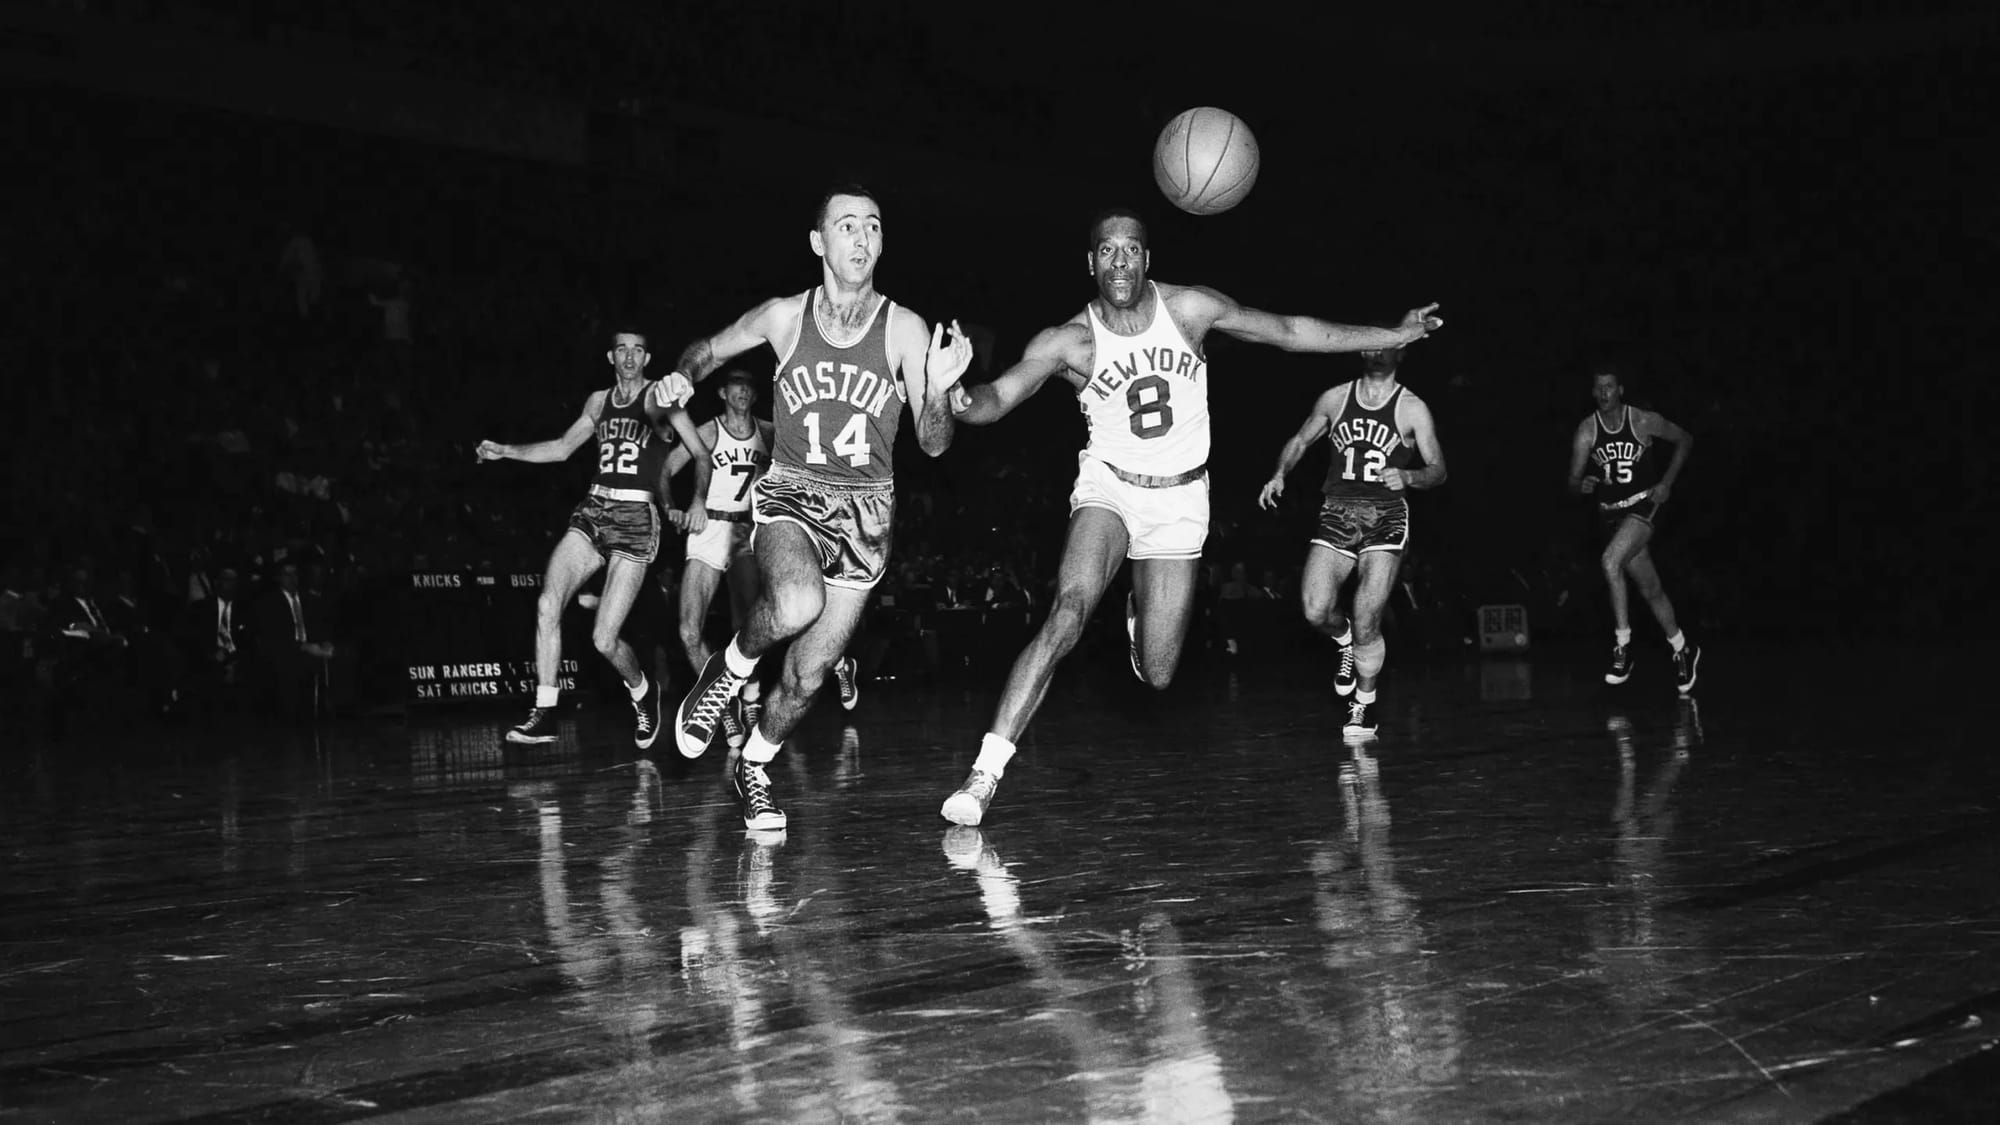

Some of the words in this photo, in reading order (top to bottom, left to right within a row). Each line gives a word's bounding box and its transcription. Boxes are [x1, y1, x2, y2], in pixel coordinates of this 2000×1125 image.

[779, 361, 894, 418] BOSTON
[1088, 352, 1138, 401] NEW
[1143, 346, 1202, 383] YORK
[1126, 374, 1174, 440] 8
[598, 417, 653, 449] OSTON
[803, 412, 871, 467] 14
[1331, 418, 1401, 457] BOSTON
[599, 441, 640, 475] 22
[1341, 447, 1387, 482] 12
[1603, 460, 1633, 484] 15
[730, 464, 756, 502] 7
[411, 573, 462, 588] KNICKS
[510, 573, 542, 588] BOST
[409, 665, 435, 680] SUN
[442, 662, 502, 679] RANGERS
[416, 682, 442, 698] SAT
[450, 680, 499, 696] KNICKS
[520, 679, 537, 694] ST
